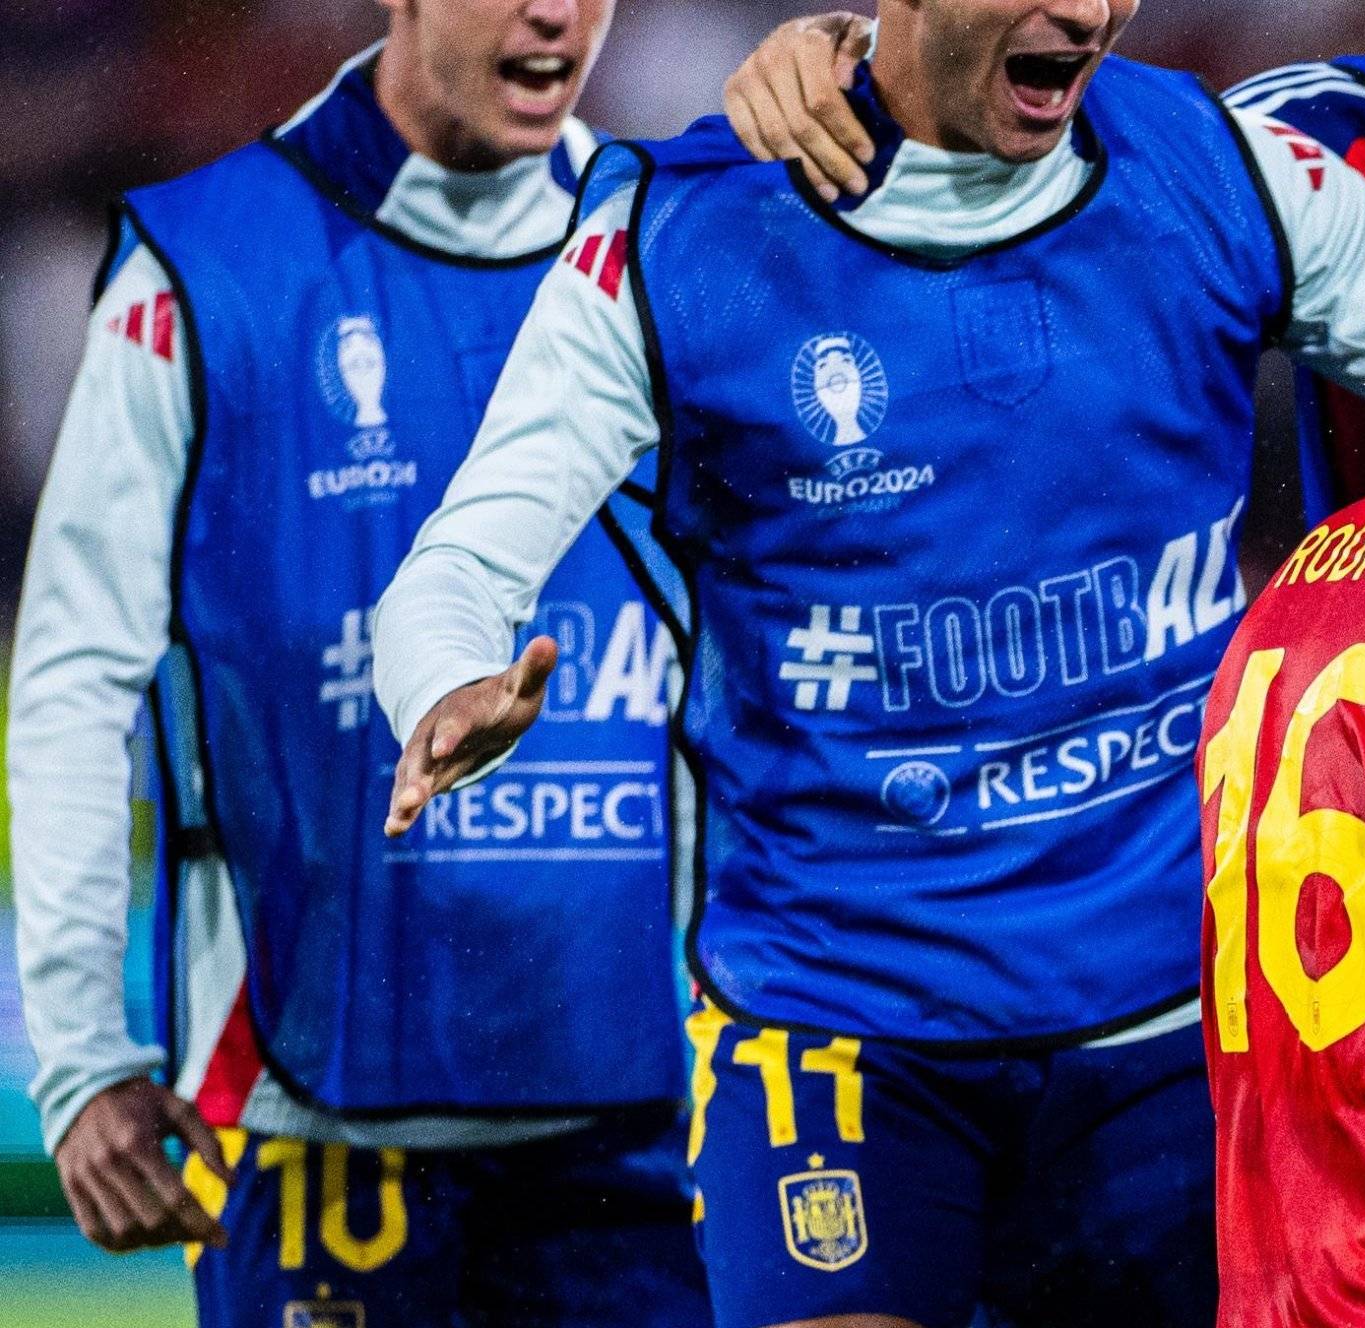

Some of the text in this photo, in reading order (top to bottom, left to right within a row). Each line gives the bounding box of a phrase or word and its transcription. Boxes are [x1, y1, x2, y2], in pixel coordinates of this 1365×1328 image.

[787, 463, 936, 504] EURO2024
[978, 694, 1207, 809] RESPEC
[732, 1027, 865, 1149] 11
[256, 1137, 409, 1273] 10
